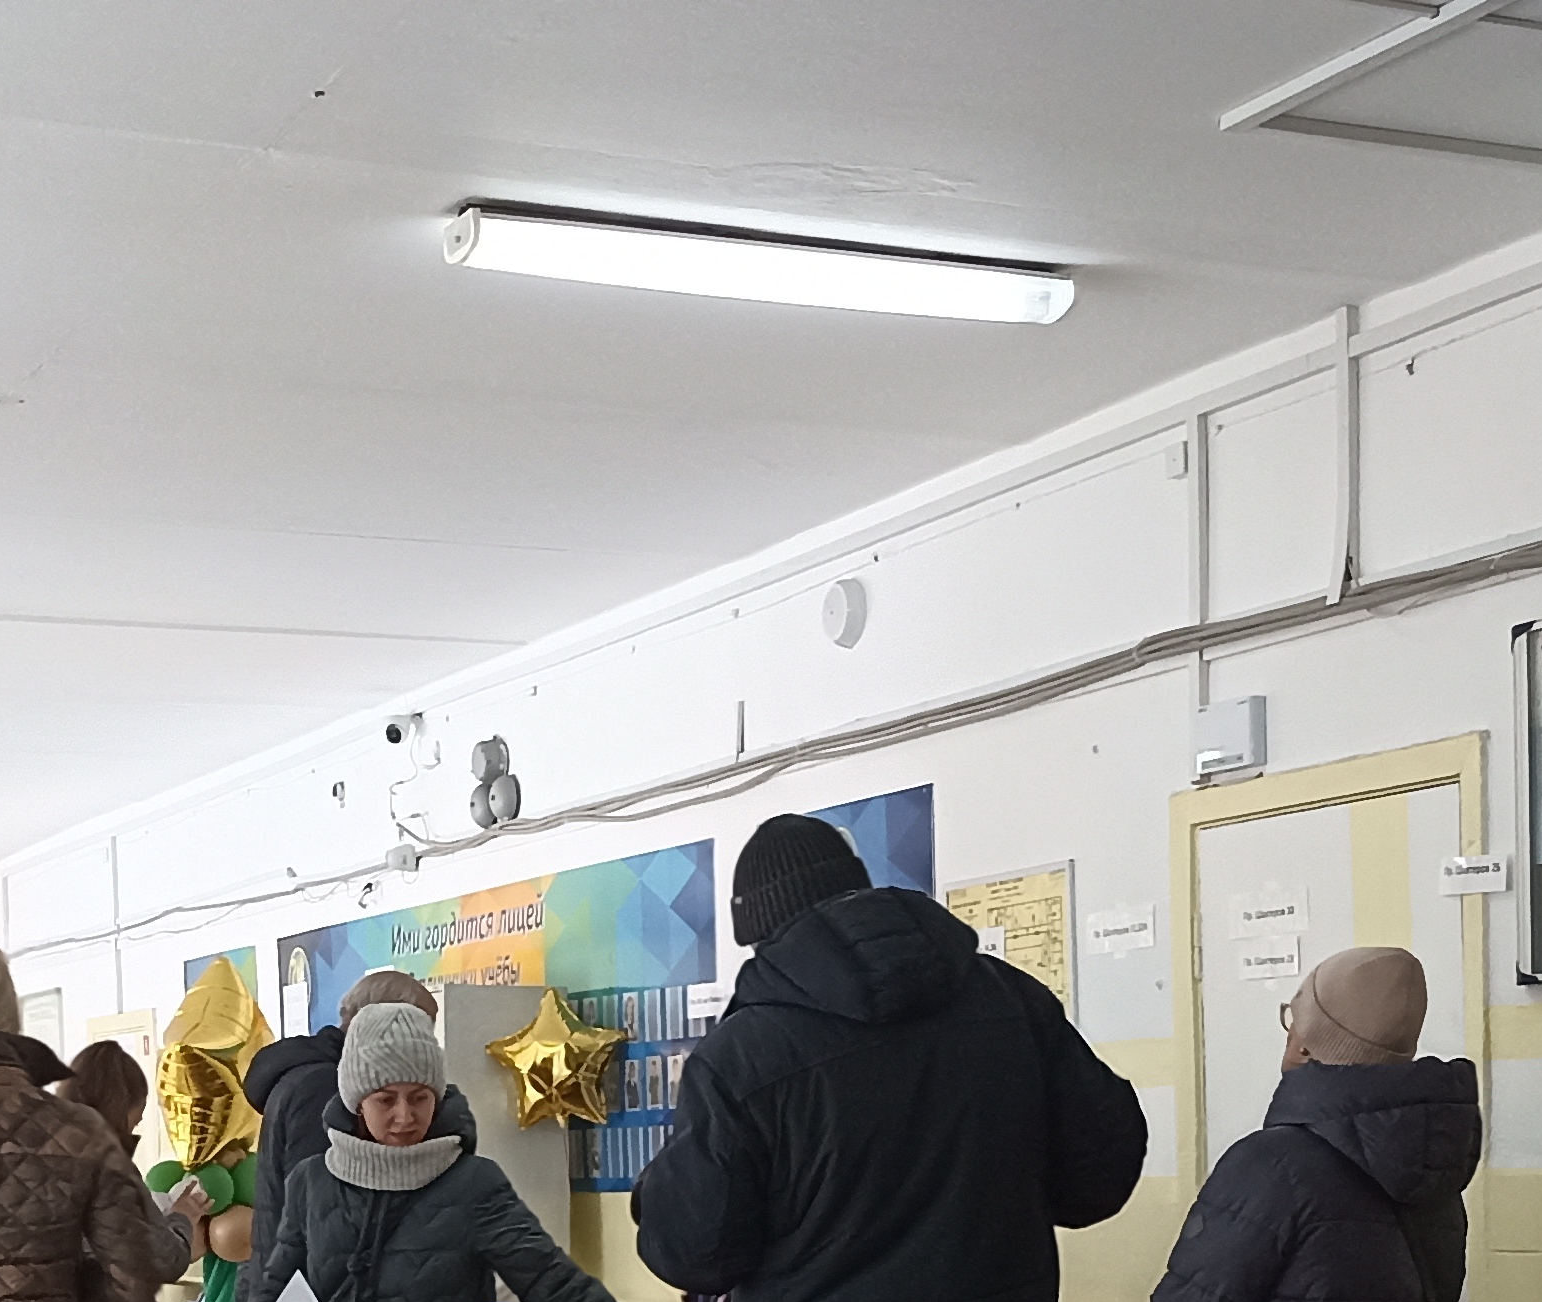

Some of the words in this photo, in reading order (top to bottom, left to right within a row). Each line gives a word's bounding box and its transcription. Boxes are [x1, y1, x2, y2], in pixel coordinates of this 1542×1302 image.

[391, 923, 422, 956] Ими
[425, 910, 495, 954] гордится
[498, 893, 545, 936] лицей
[481, 954, 522, 986] учёбы
